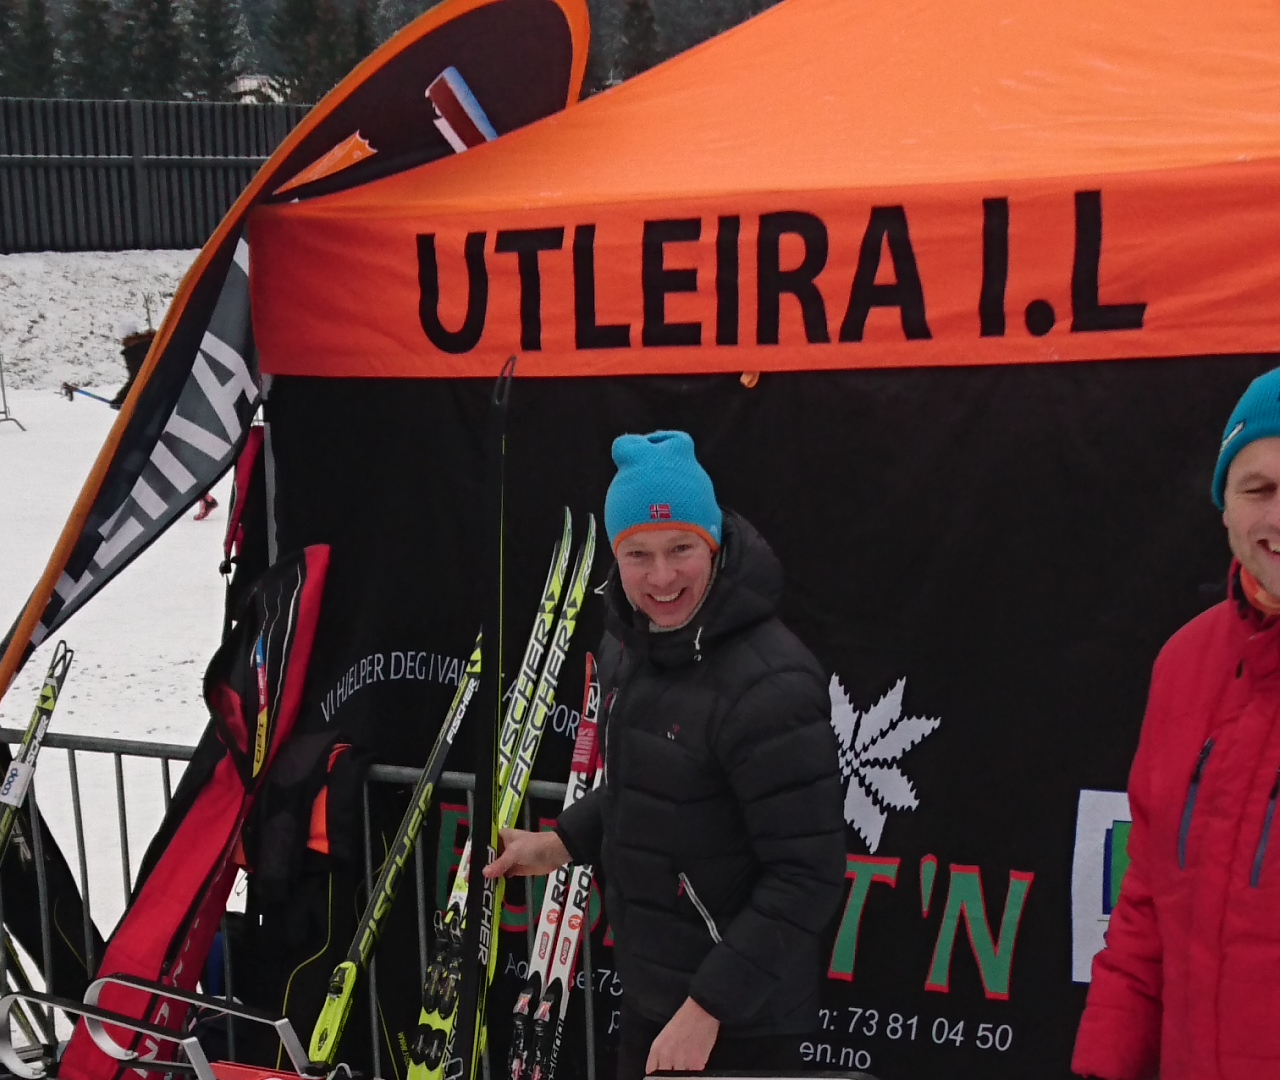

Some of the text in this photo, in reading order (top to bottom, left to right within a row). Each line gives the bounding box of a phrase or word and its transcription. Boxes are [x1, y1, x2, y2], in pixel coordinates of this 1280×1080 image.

[416, 189, 1148, 355] UTLEIRA I.L
[320, 689, 336, 723] VI
[336, 652, 384, 701] HJELPER
[389, 650, 427, 681] DEG
[445, 676, 478, 745] FISCHER
[509, 620, 571, 798] FISCHER
[26, 714, 50, 767] SCHER
[1, 766, 19, 797] coop
[847, 1006, 879, 1037] 73
[886, 1012, 919, 1041] 81
[931, 1017, 965, 1047] 04
[975, 1023, 1013, 1052] 50
